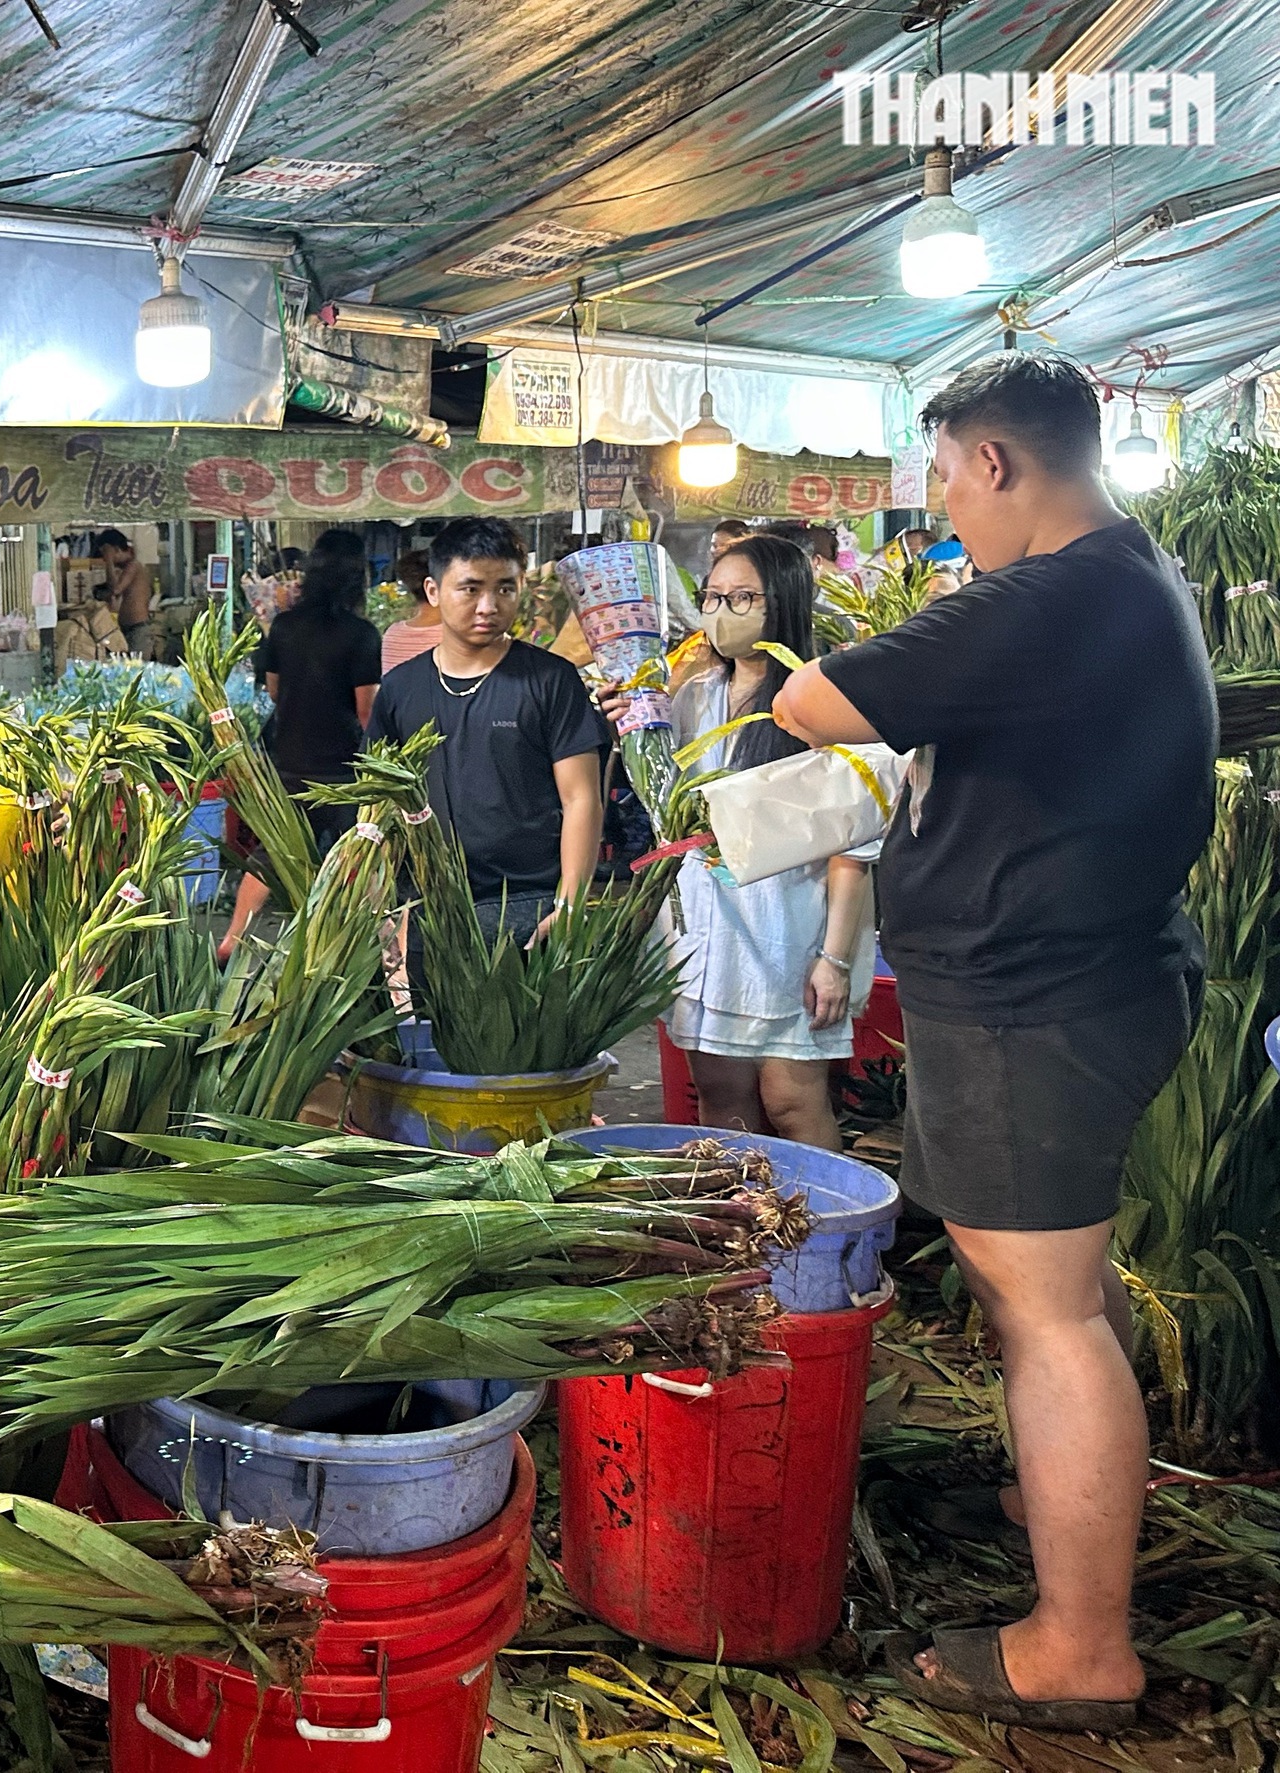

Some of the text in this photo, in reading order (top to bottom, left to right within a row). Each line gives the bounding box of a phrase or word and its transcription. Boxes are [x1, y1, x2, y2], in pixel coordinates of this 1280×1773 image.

[64, 433, 166, 514] Tươi
[183, 446, 532, 517] QUỐC
[787, 473, 892, 517] QU
